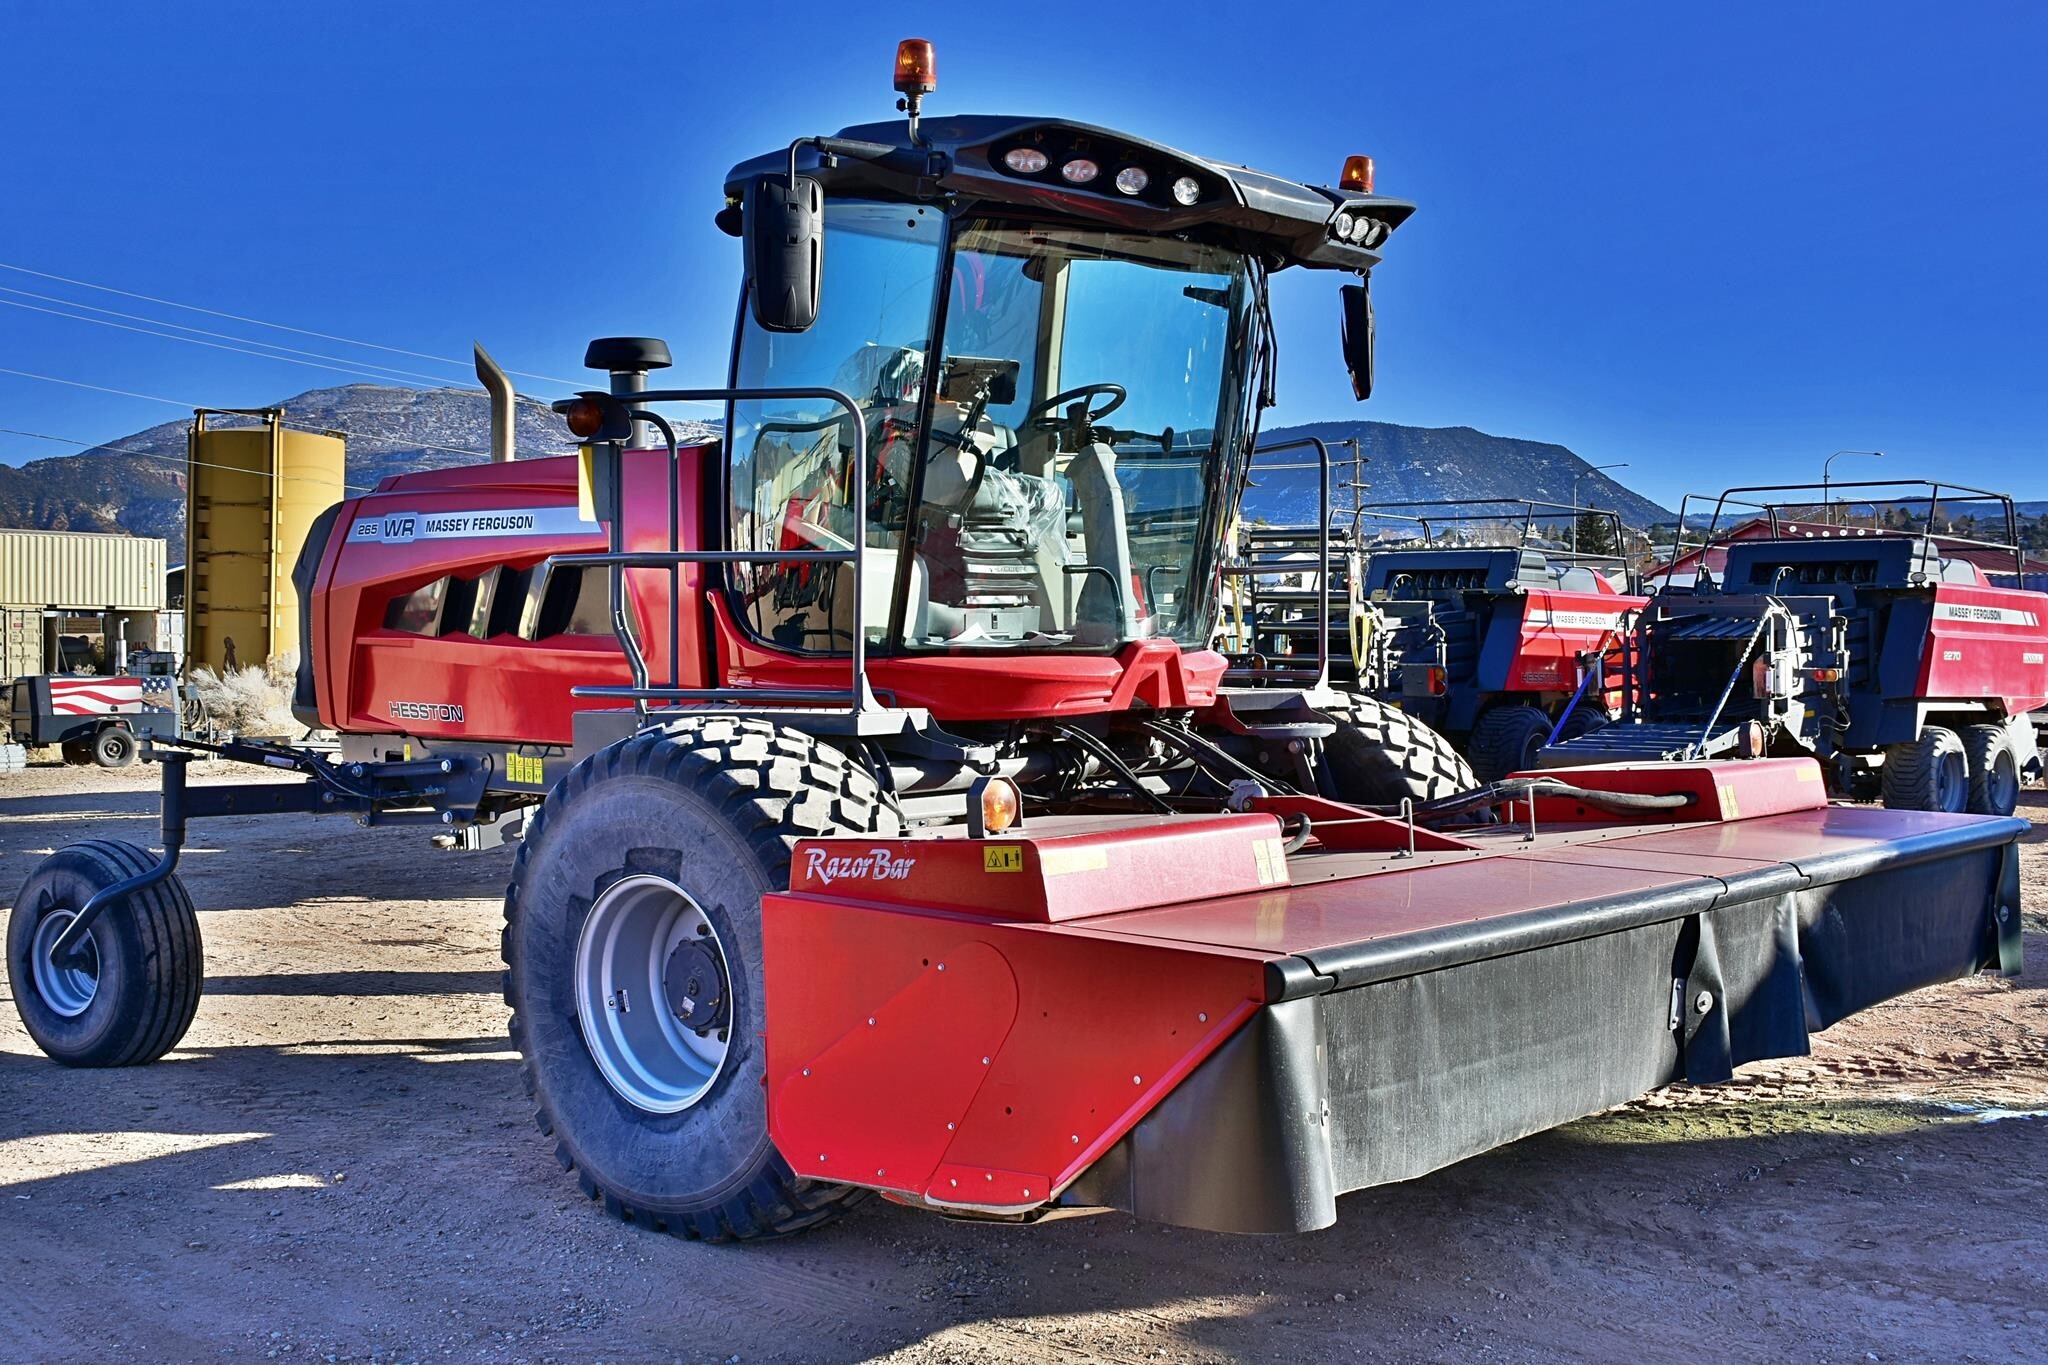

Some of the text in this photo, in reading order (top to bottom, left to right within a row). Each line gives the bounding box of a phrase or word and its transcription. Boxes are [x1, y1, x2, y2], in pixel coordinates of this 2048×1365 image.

[358, 515, 534, 538] 265 WR MASSEY FERGUSON
[1555, 615, 1578, 624] MASSEY
[1579, 616, 1606, 625] FERGUSON
[1948, 606, 2002, 621] MASSEY FERGUSON
[388, 701, 464, 723] HESSTON
[804, 848, 917, 885] RazorBar
